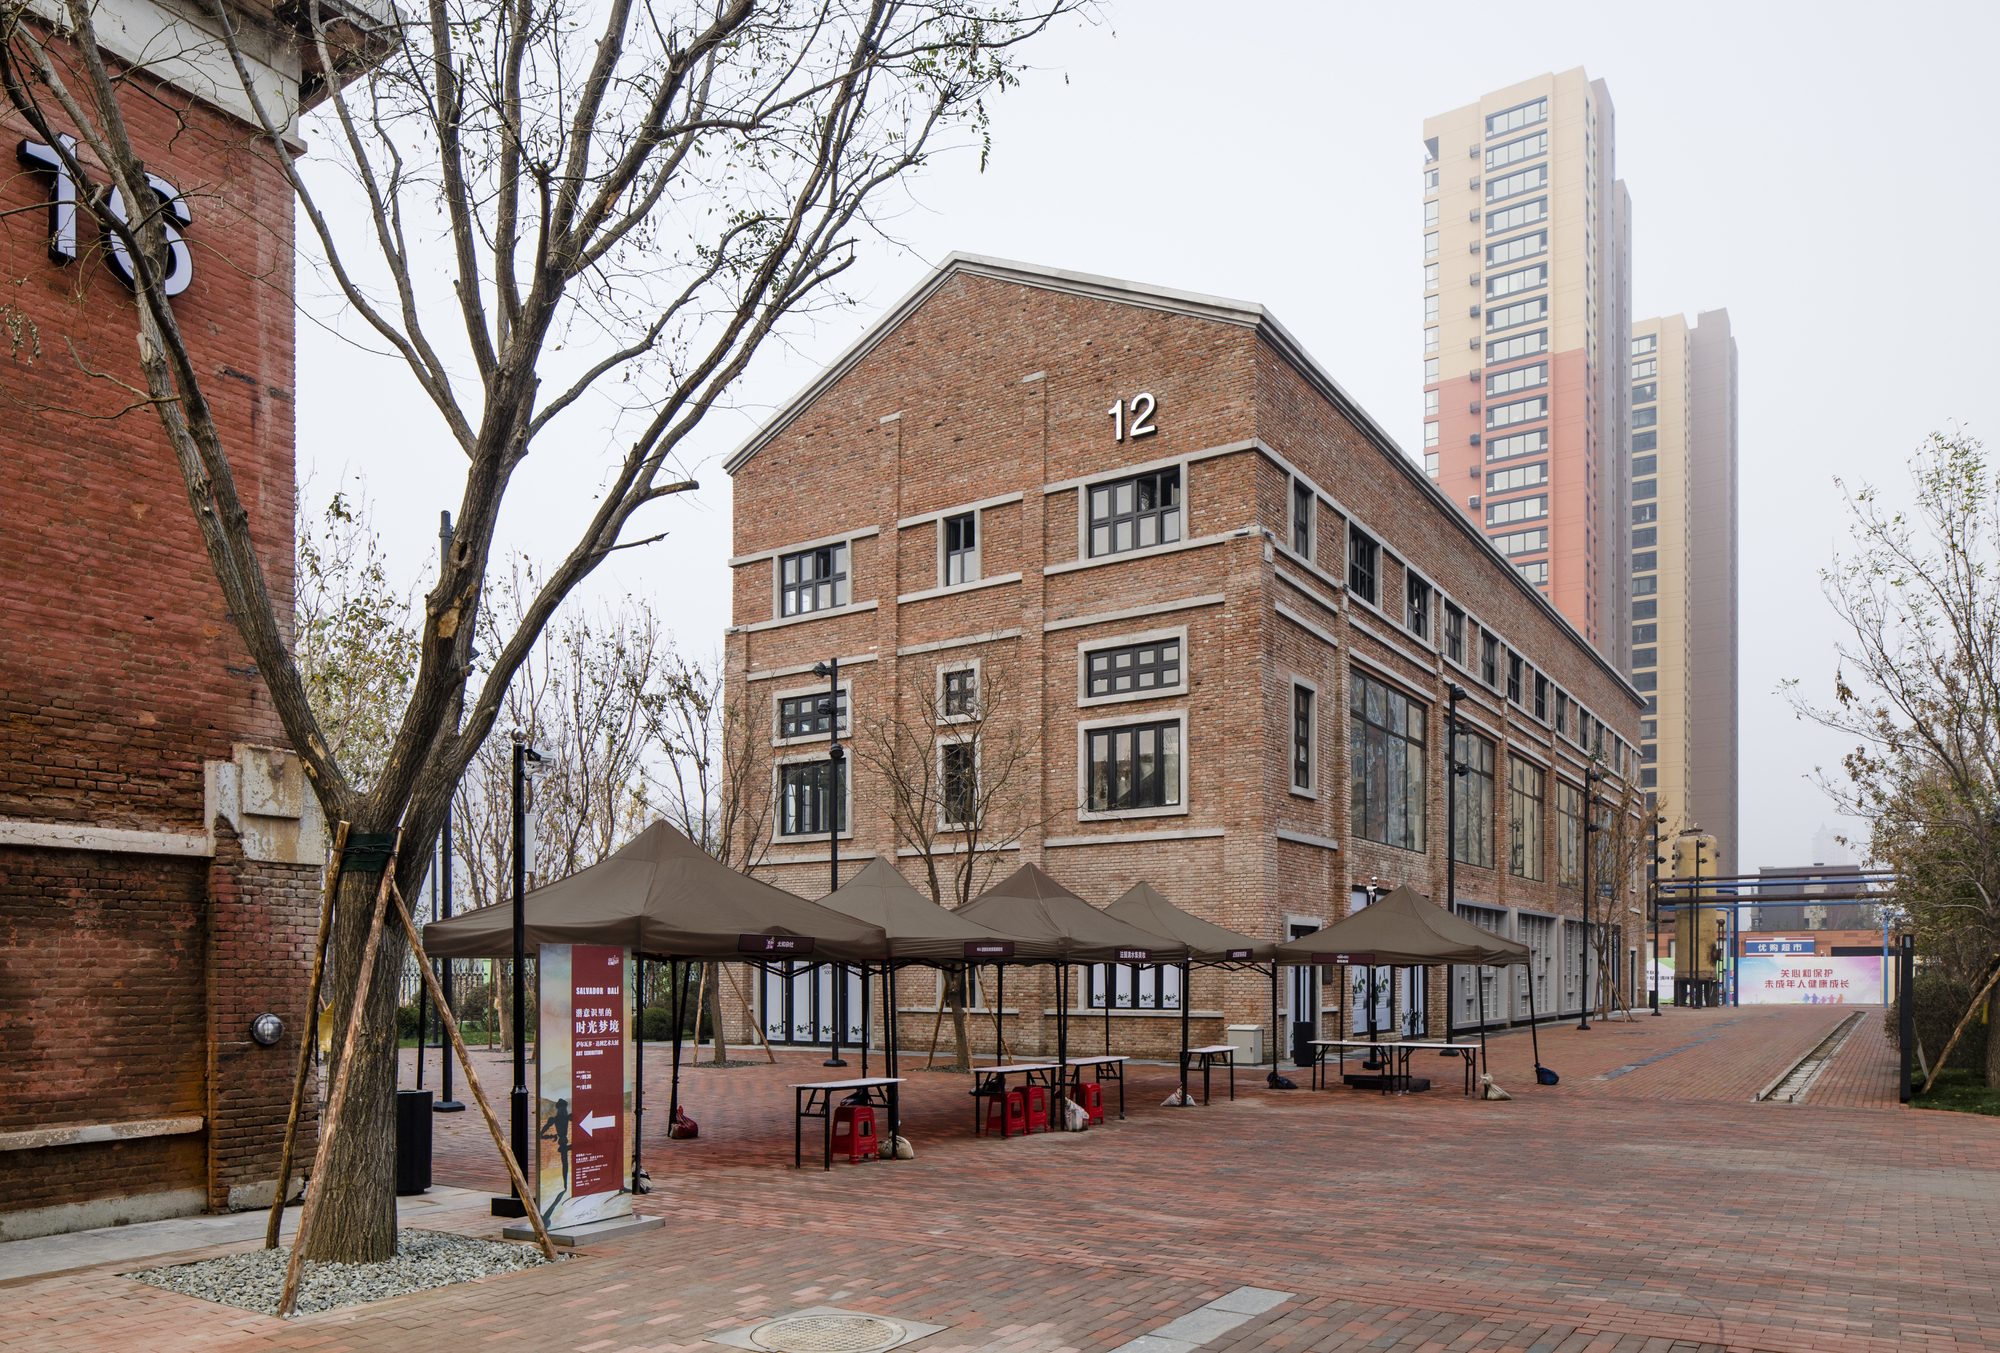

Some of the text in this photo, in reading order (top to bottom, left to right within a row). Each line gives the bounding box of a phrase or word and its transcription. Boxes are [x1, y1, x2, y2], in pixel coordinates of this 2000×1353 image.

[1108, 392, 1157, 442] 12
[1757, 943, 1803, 952] 优购超市
[1780, 969, 1834, 978] 关心和保护
[1764, 979, 1850, 989] 未成年人健康成长
[575, 985, 620, 995] SALVADOR DALÍ
[575, 1007, 612, 1018] 潜意识里的
[575, 1019, 620, 1035] 时光梦境
